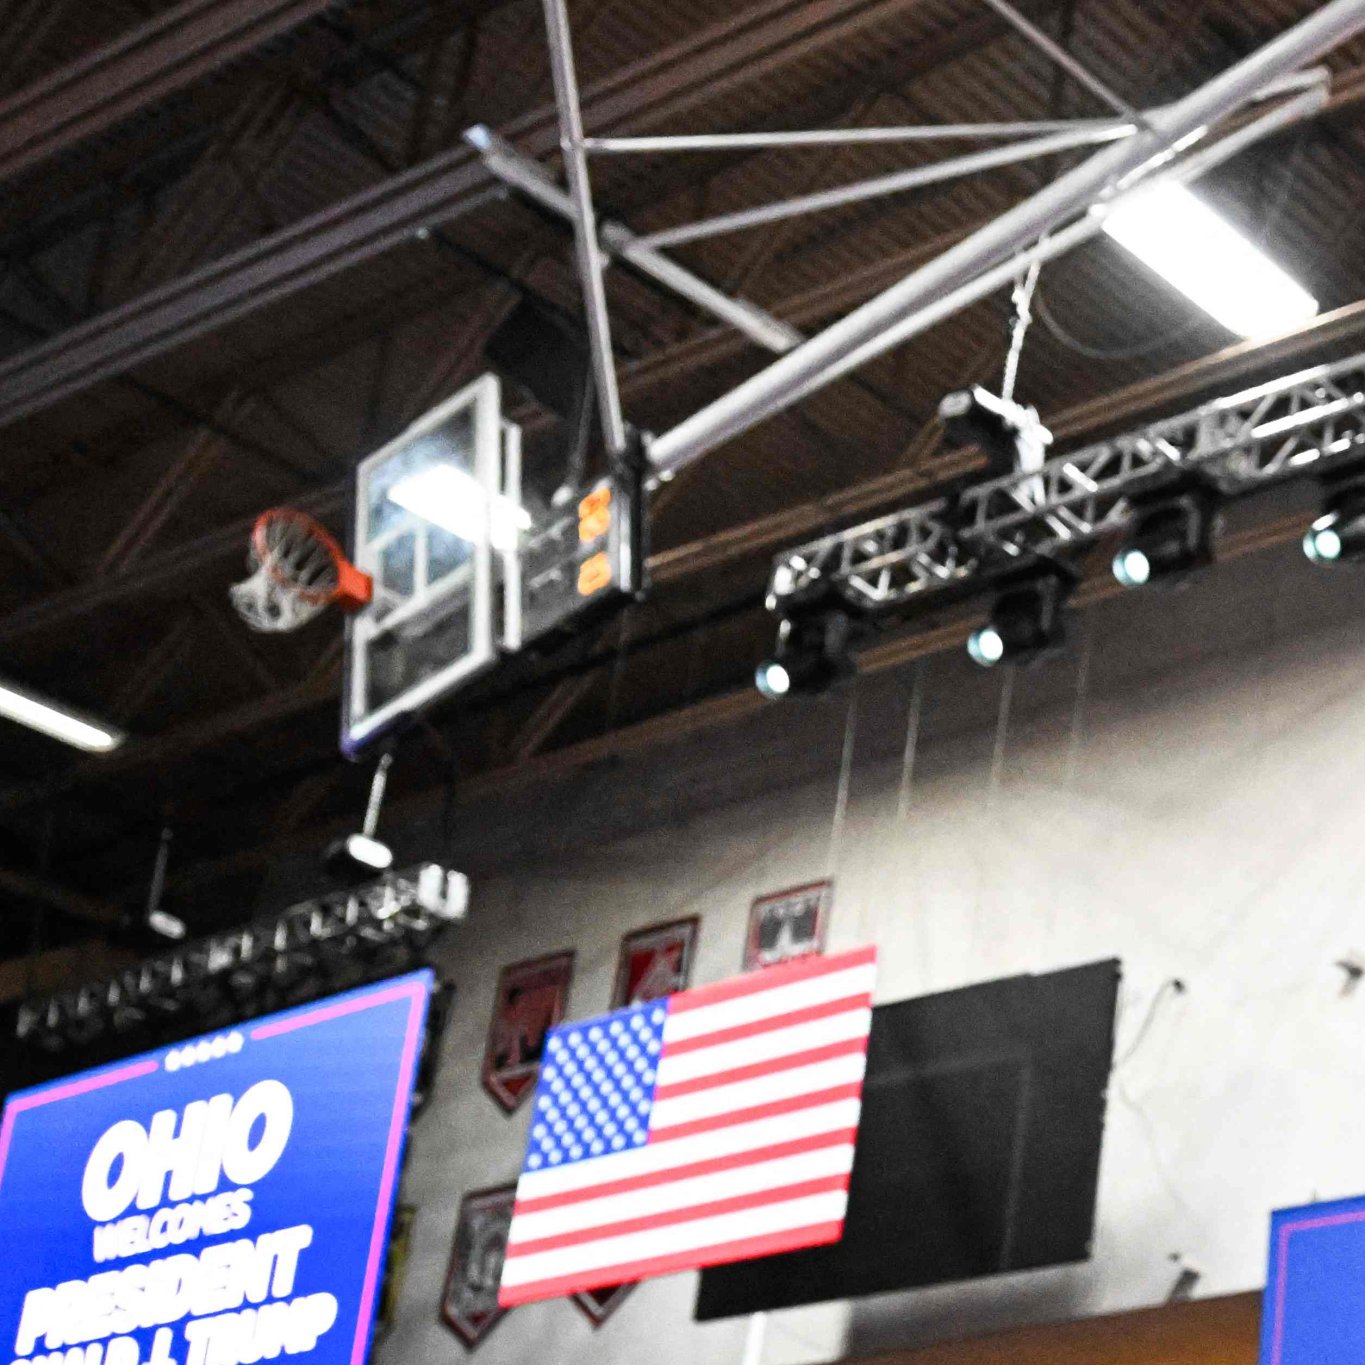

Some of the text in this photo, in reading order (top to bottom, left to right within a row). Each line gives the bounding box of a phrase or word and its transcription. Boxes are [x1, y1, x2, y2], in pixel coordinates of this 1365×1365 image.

[82, 1079, 294, 1222] OHIO
[15, 1224, 313, 1356] PRESIDENT
[93, 1188, 254, 1262] WELCOMES
